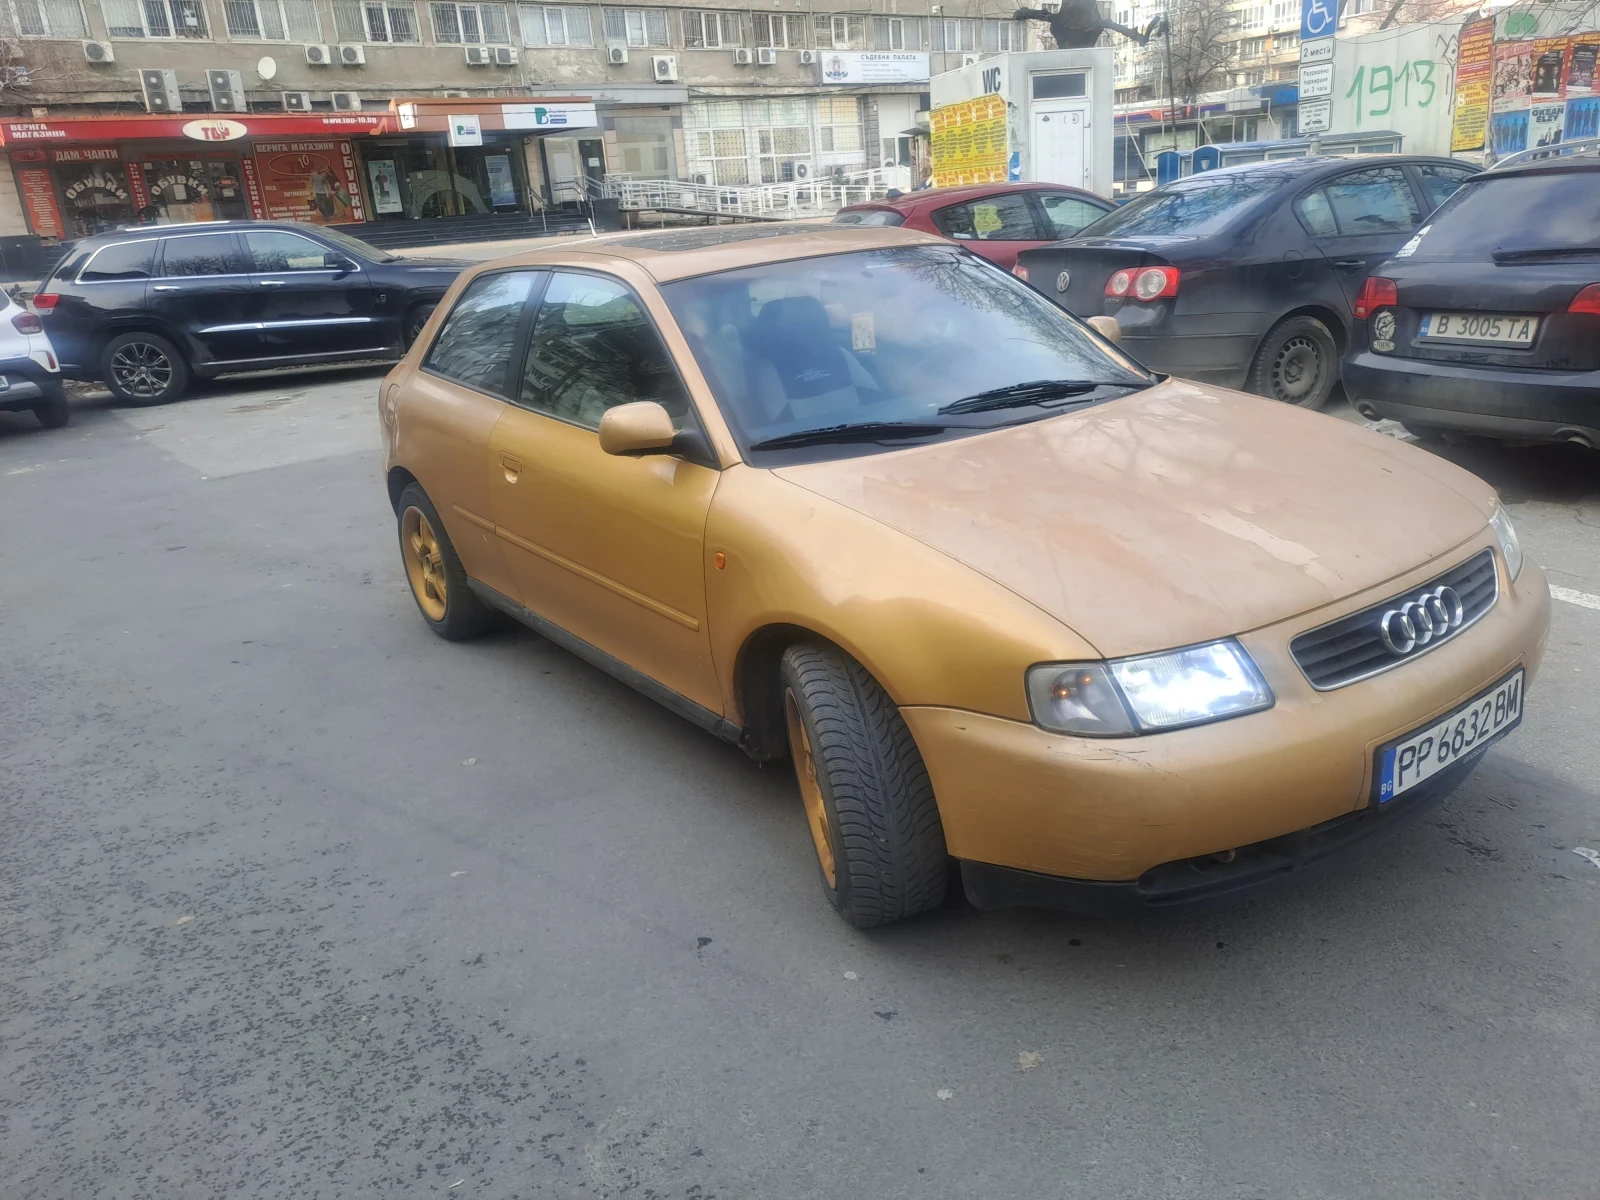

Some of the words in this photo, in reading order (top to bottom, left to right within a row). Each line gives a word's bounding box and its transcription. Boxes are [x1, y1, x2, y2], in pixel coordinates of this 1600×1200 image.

[1303, 47, 1309, 58] 2
[1310, 46, 1331, 57] места
[982, 66, 1002, 94] WC
[1303, 68, 1330, 77] Разрешено
[1303, 77, 1329, 86] паркиране
[1345, 60, 1436, 126] 1913
[1457, 92, 1465, 107] 8
[1531, 106, 1565, 117] OKEAN
[1536, 114, 1559, 123] ELZY
[10, 123, 48, 132] ВЕРИГА
[322, 116, 378, 124] www.top-10.bg
[12, 130, 66, 139] МАГАЗИНИ
[256, 143, 288, 153] ВЕРИГА
[291, 142, 334, 151] МАГАЗИНИ
[55, 150, 83, 162] ДАМ.
[84, 149, 118, 160] ЧАНТИ
[298, 154, 310, 169] 10
[151, 174, 209, 197] ОБУВКИ
[243, 159, 260, 206] ПОСТОЯННА
[340, 142, 363, 220] ОБУВКИ
[65, 178, 128, 200] ОБУВКИ
[1436, 315, 1450, 335] B
[1456, 317, 1503, 337] 3005
[1507, 318, 1530, 340] TA
[1398, 735, 1434, 788] PP
[1437, 701, 1493, 763] 6832
[1493, 678, 1519, 729] BM
[1381, 780, 1393, 796] BG
